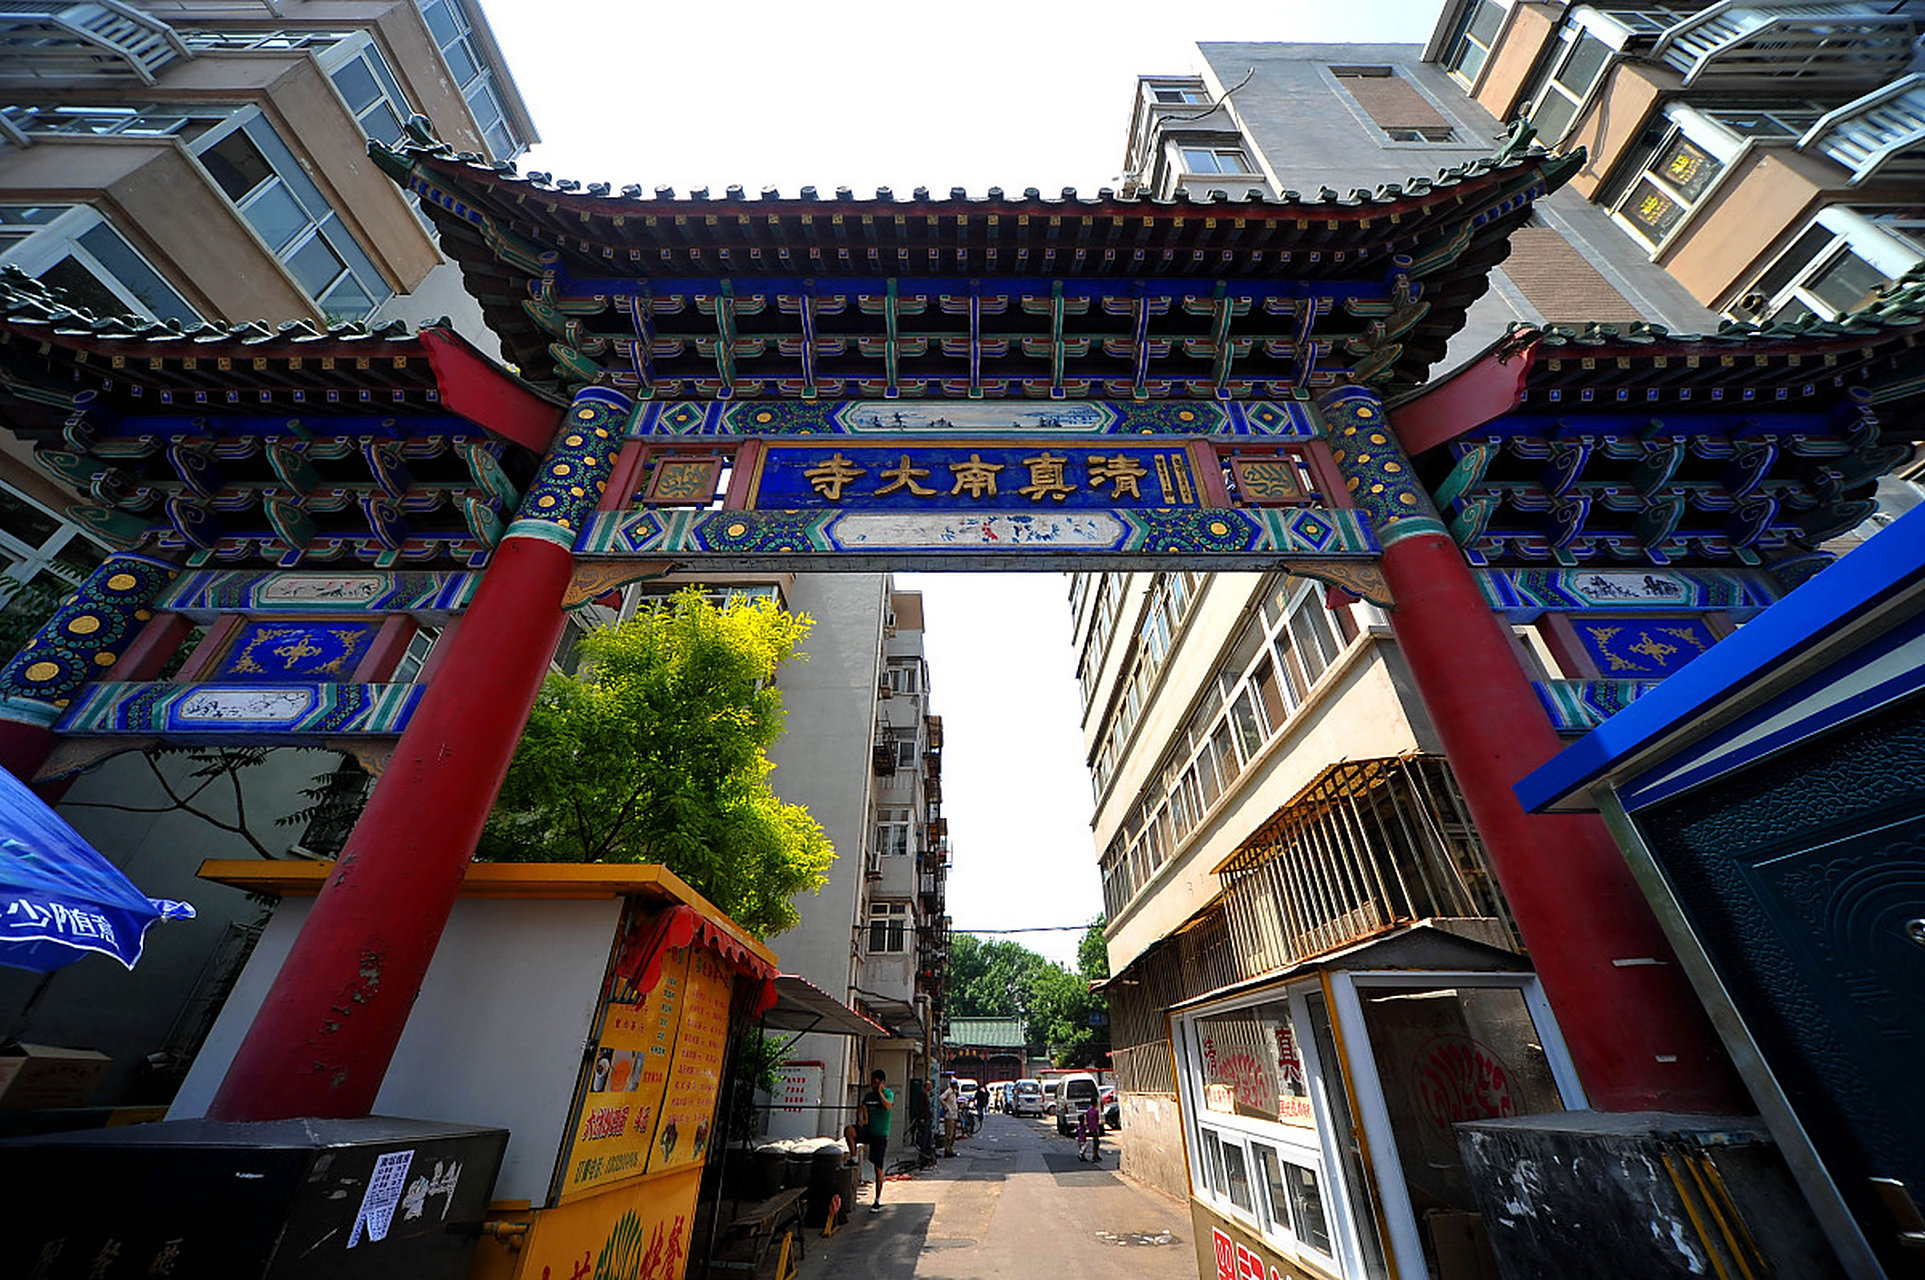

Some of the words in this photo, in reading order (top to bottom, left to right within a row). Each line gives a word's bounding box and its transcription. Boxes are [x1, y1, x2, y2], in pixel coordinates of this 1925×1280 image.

[0, 899, 119, 950] 少随意
[1275, 1026, 1301, 1081] 真
